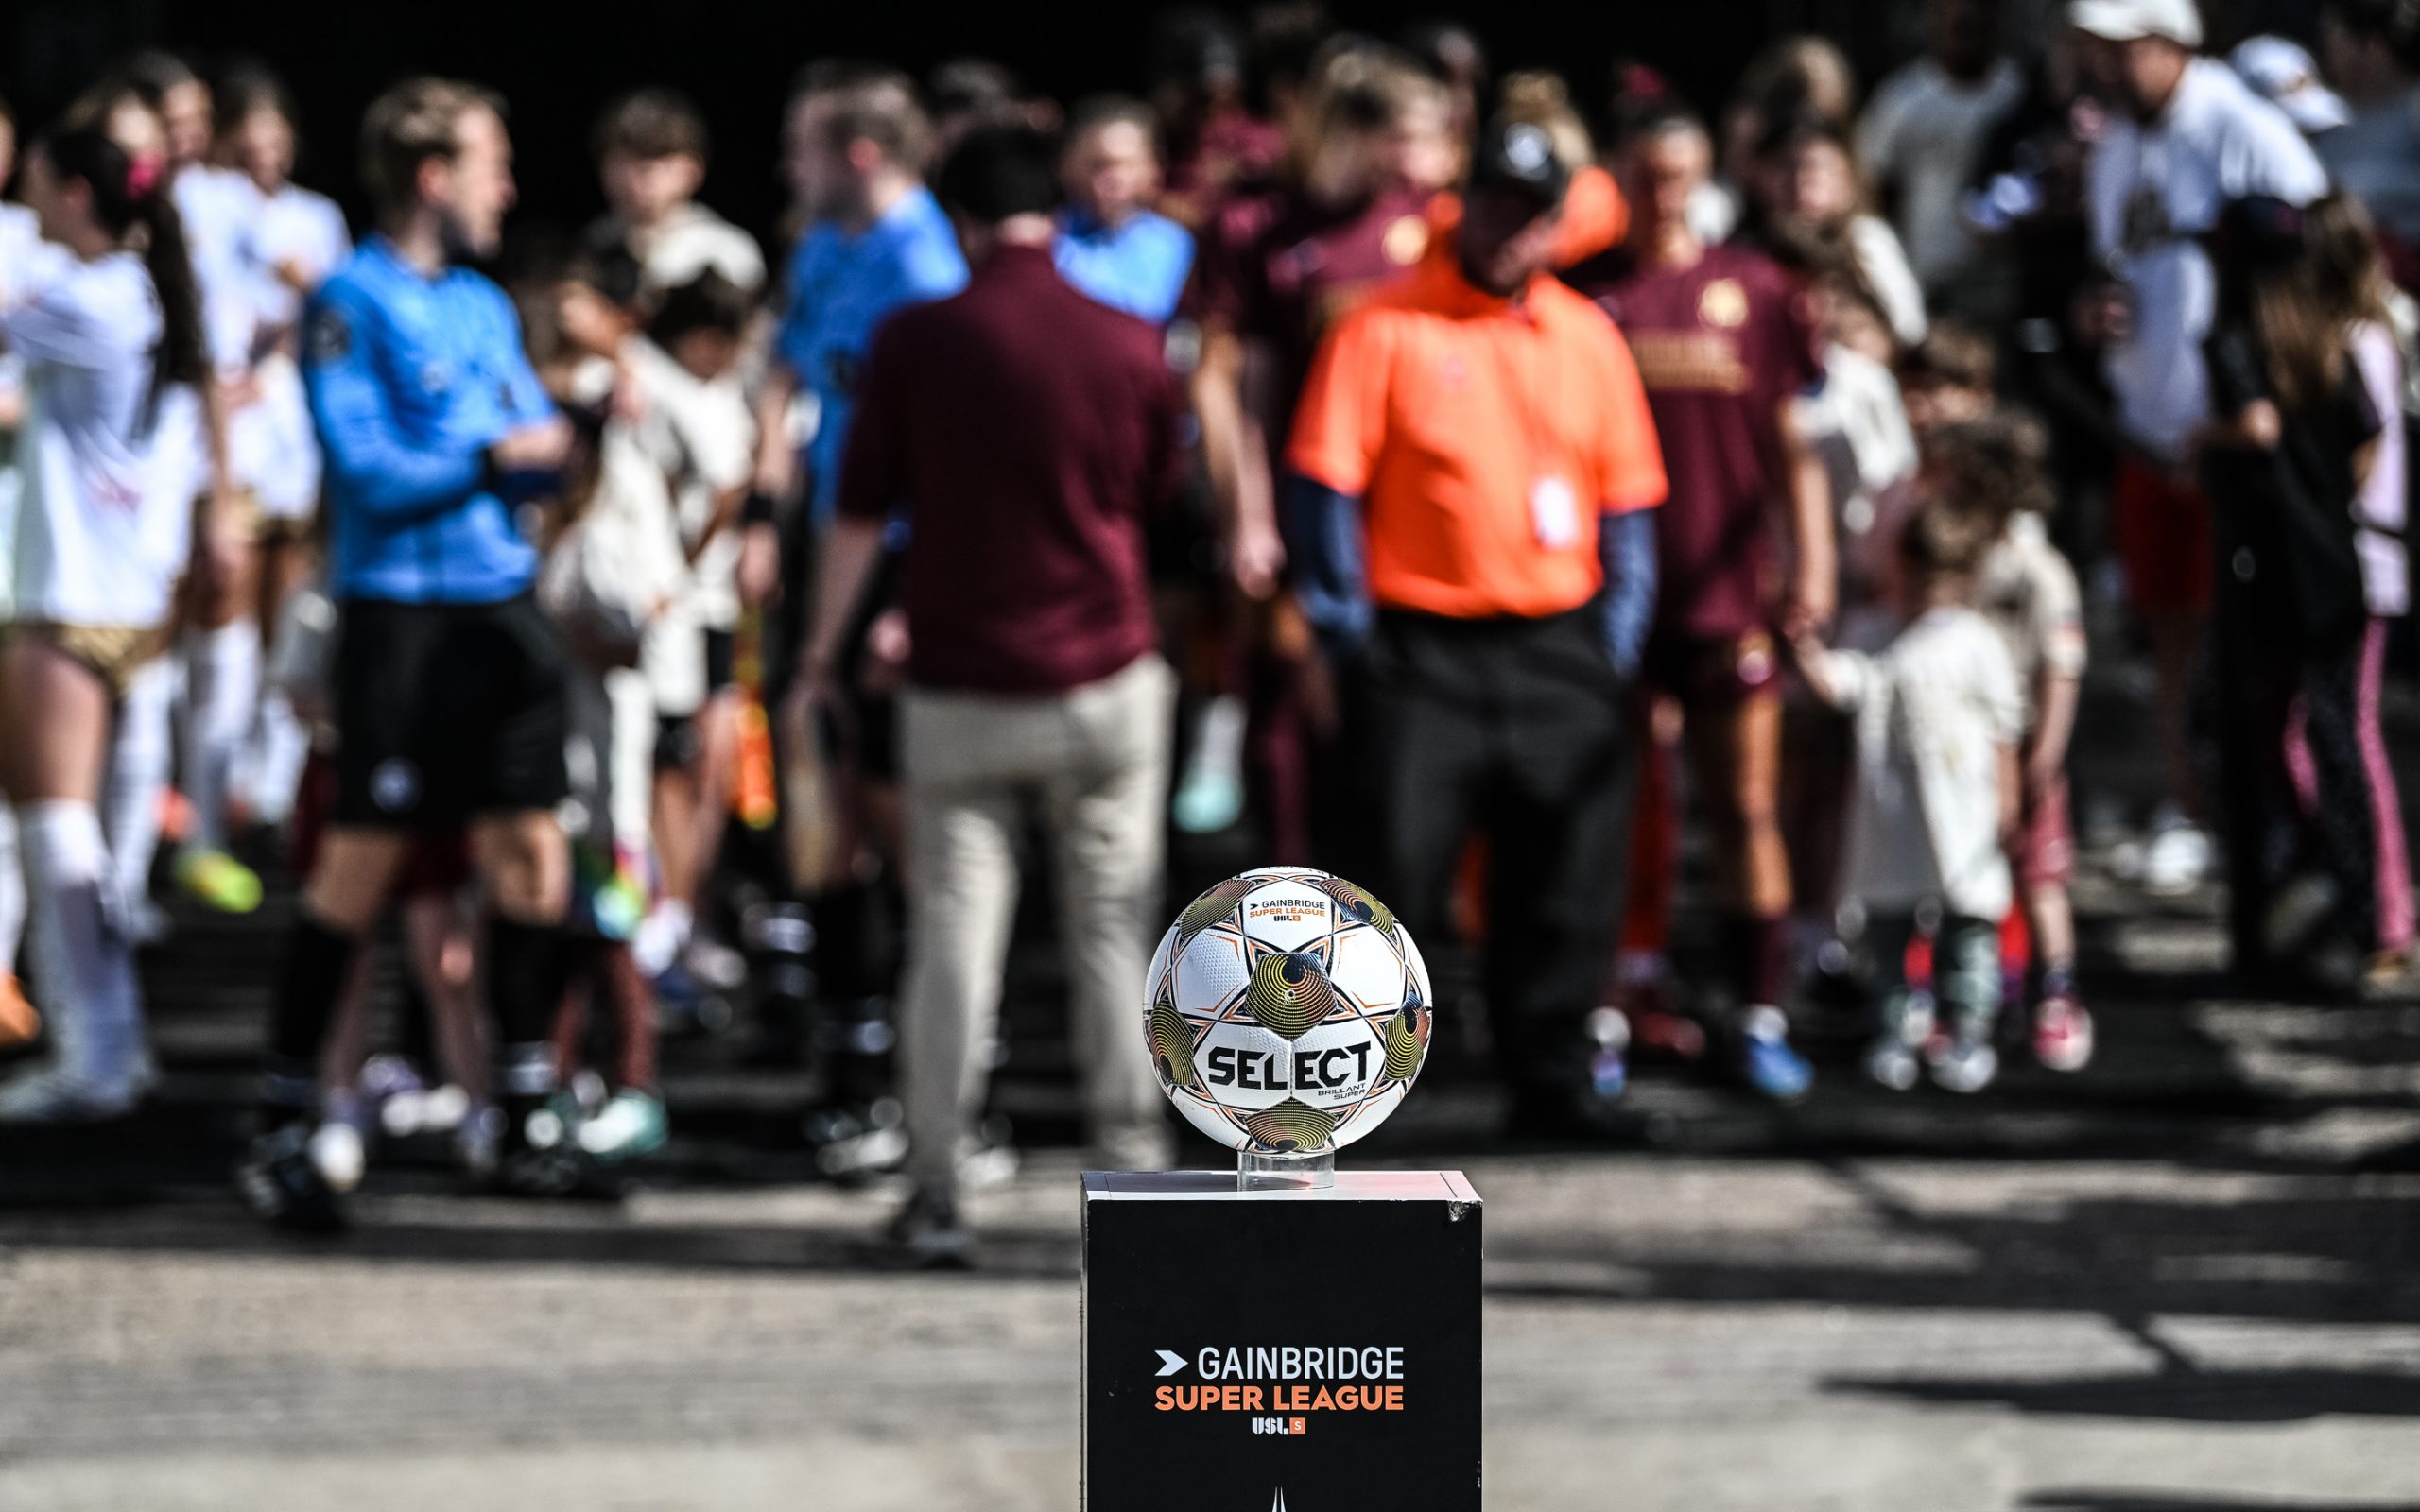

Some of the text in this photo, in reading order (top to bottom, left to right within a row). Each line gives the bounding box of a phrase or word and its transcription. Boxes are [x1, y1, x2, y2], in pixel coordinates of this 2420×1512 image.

[1262, 900, 1325, 909] GAINBRIDGE
[1250, 908, 1325, 918] SUPER LEAGUE
[1208, 1040, 1371, 1090] SELECT
[1318, 1083, 1365, 1096] BRILLANT
[1334, 1090, 1365, 1100] SUPER
[1198, 1347, 1404, 1380] GAINBRIDGE
[1154, 1384, 1404, 1411] SUPER LEAGUE
